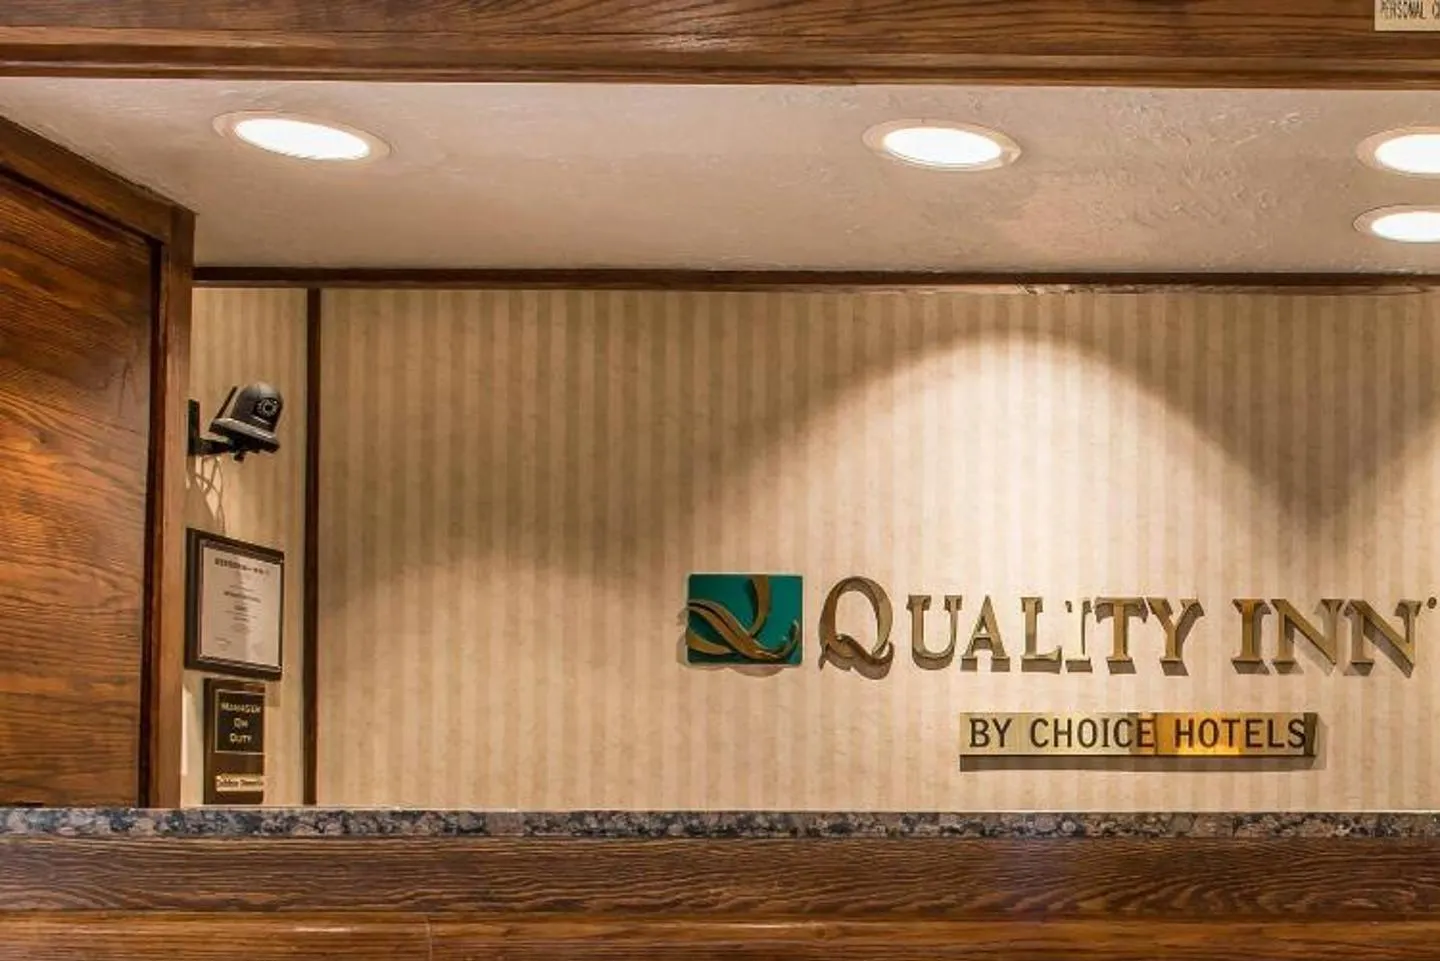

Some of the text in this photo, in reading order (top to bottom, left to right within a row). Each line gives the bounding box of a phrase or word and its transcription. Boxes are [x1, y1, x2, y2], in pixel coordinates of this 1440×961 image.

[1380, 0, 1426, 20] PERSONAL
[819, 576, 1424, 679] QUALITY INN
[968, 717, 1307, 749] BY CHOICE HOTELS
